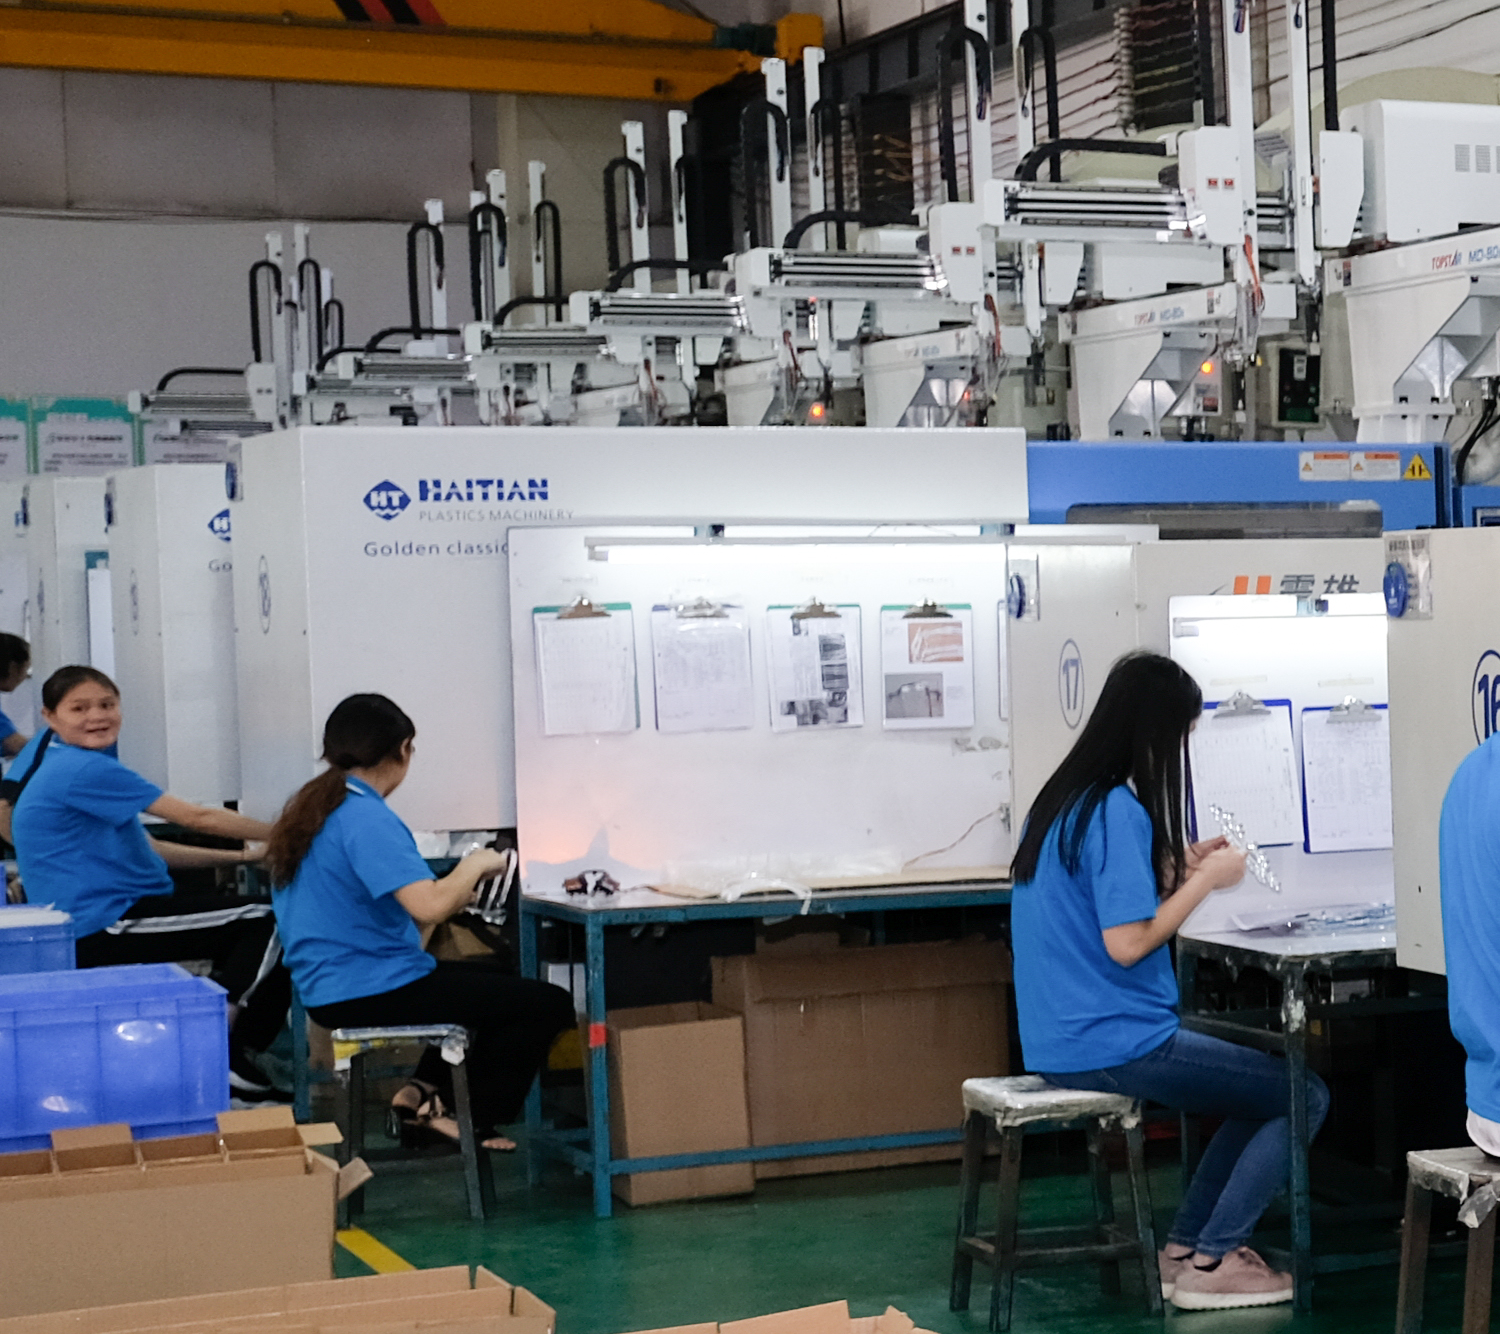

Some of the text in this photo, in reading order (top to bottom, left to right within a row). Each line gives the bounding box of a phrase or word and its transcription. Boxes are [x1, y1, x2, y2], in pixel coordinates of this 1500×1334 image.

[418, 479, 549, 502] HAITIAN
[419, 509, 574, 523] PLASTICS MACHINERY
[363, 540, 440, 558] Golden
[1062, 658, 1080, 710] 17
